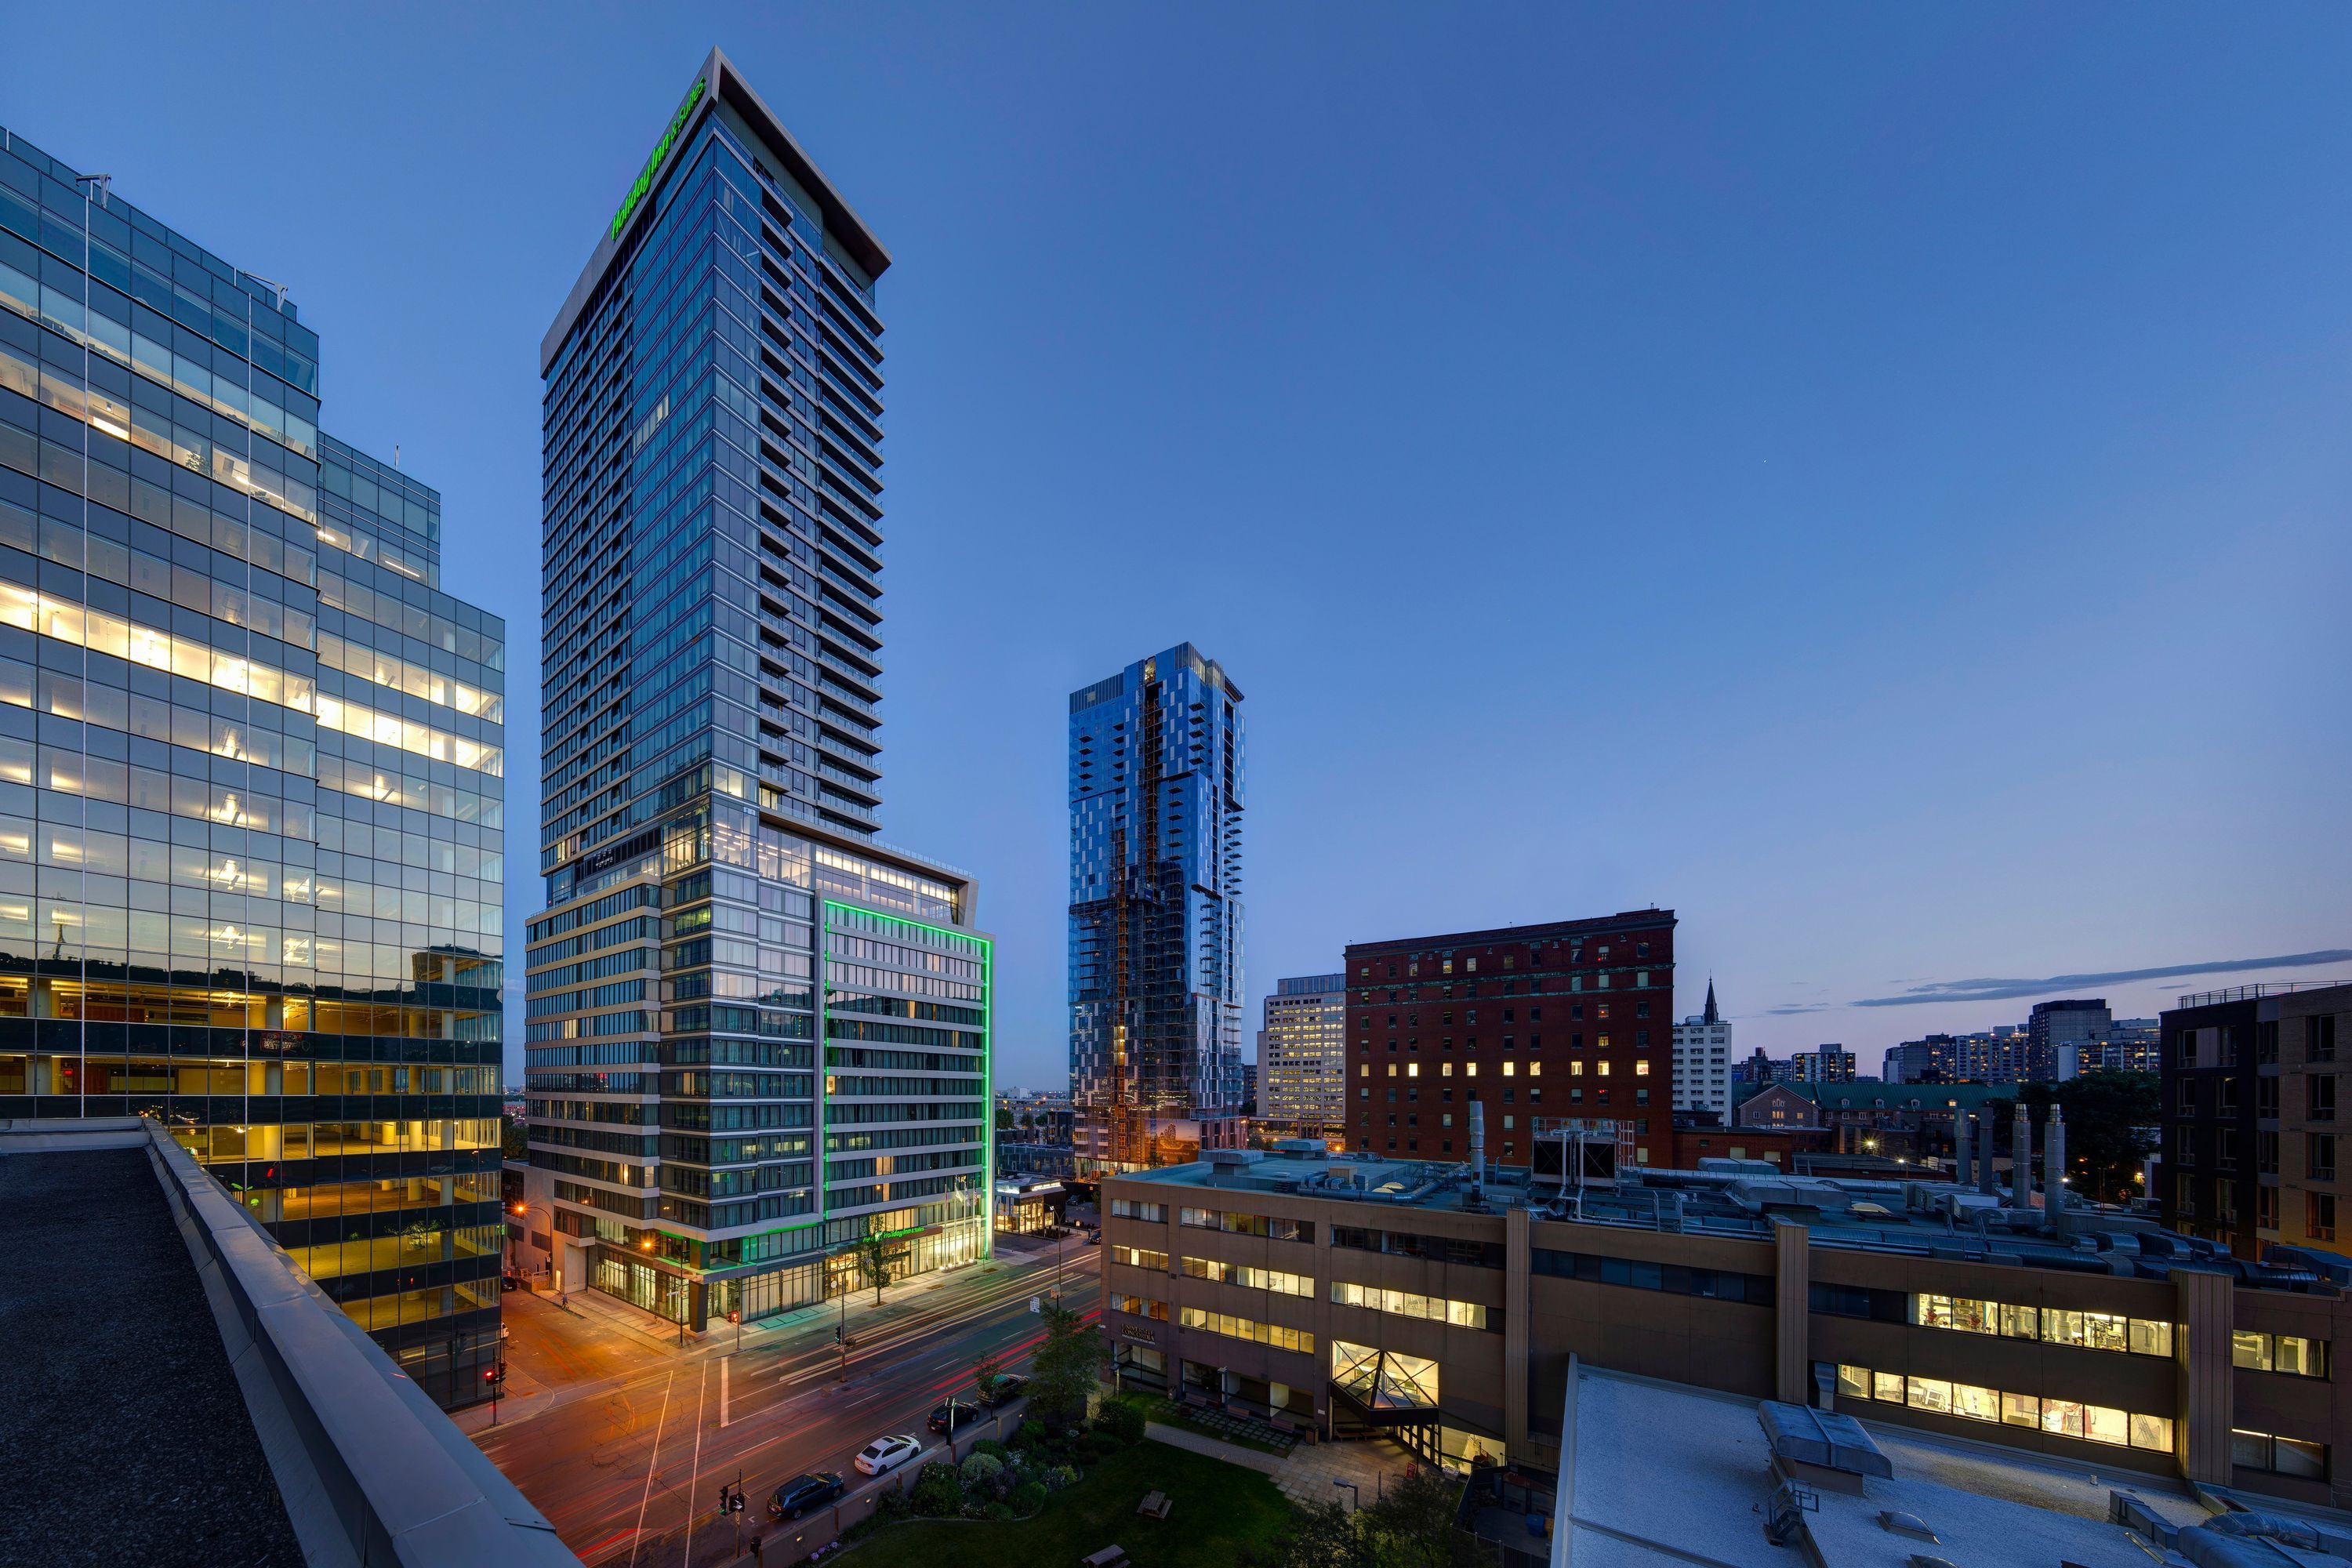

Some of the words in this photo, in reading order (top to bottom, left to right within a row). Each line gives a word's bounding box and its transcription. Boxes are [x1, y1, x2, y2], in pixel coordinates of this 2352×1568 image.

[612, 164, 652, 241] Holiday
[651, 133, 670, 172] Inn
[670, 119, 679, 141] &
[678, 76, 706, 128] Suites
[1121, 1329, 1155, 1341] CONCORDIA
